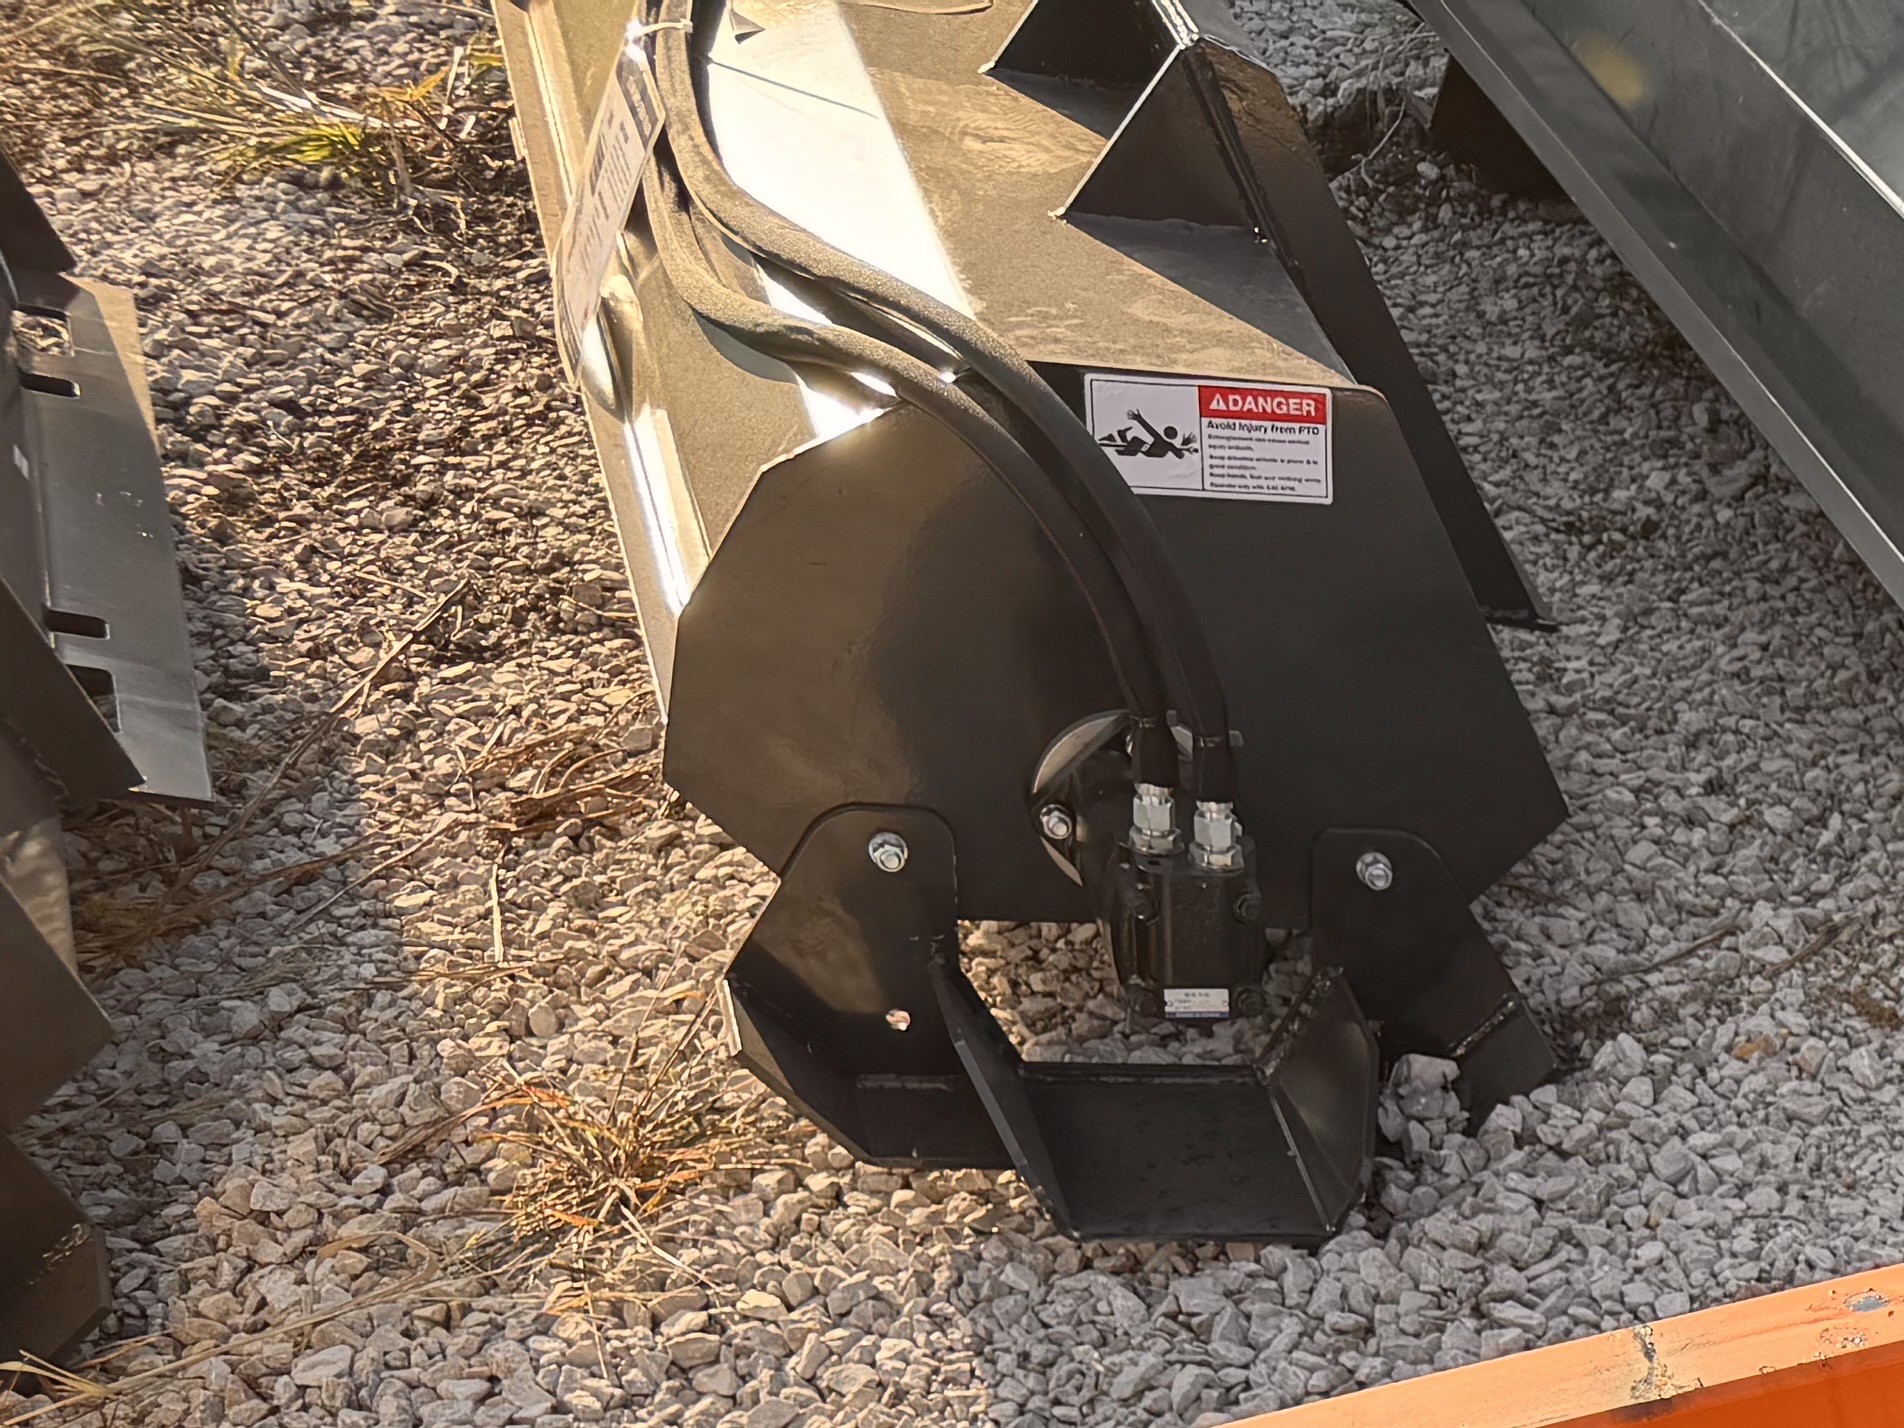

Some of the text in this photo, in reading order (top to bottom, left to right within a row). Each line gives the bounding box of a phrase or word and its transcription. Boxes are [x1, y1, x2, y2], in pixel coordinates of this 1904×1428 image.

[1227, 394, 1316, 417] DANGER
[1207, 419, 1237, 431] Avoid
[1271, 423, 1296, 434] from
[1298, 425, 1320, 436] PTO
